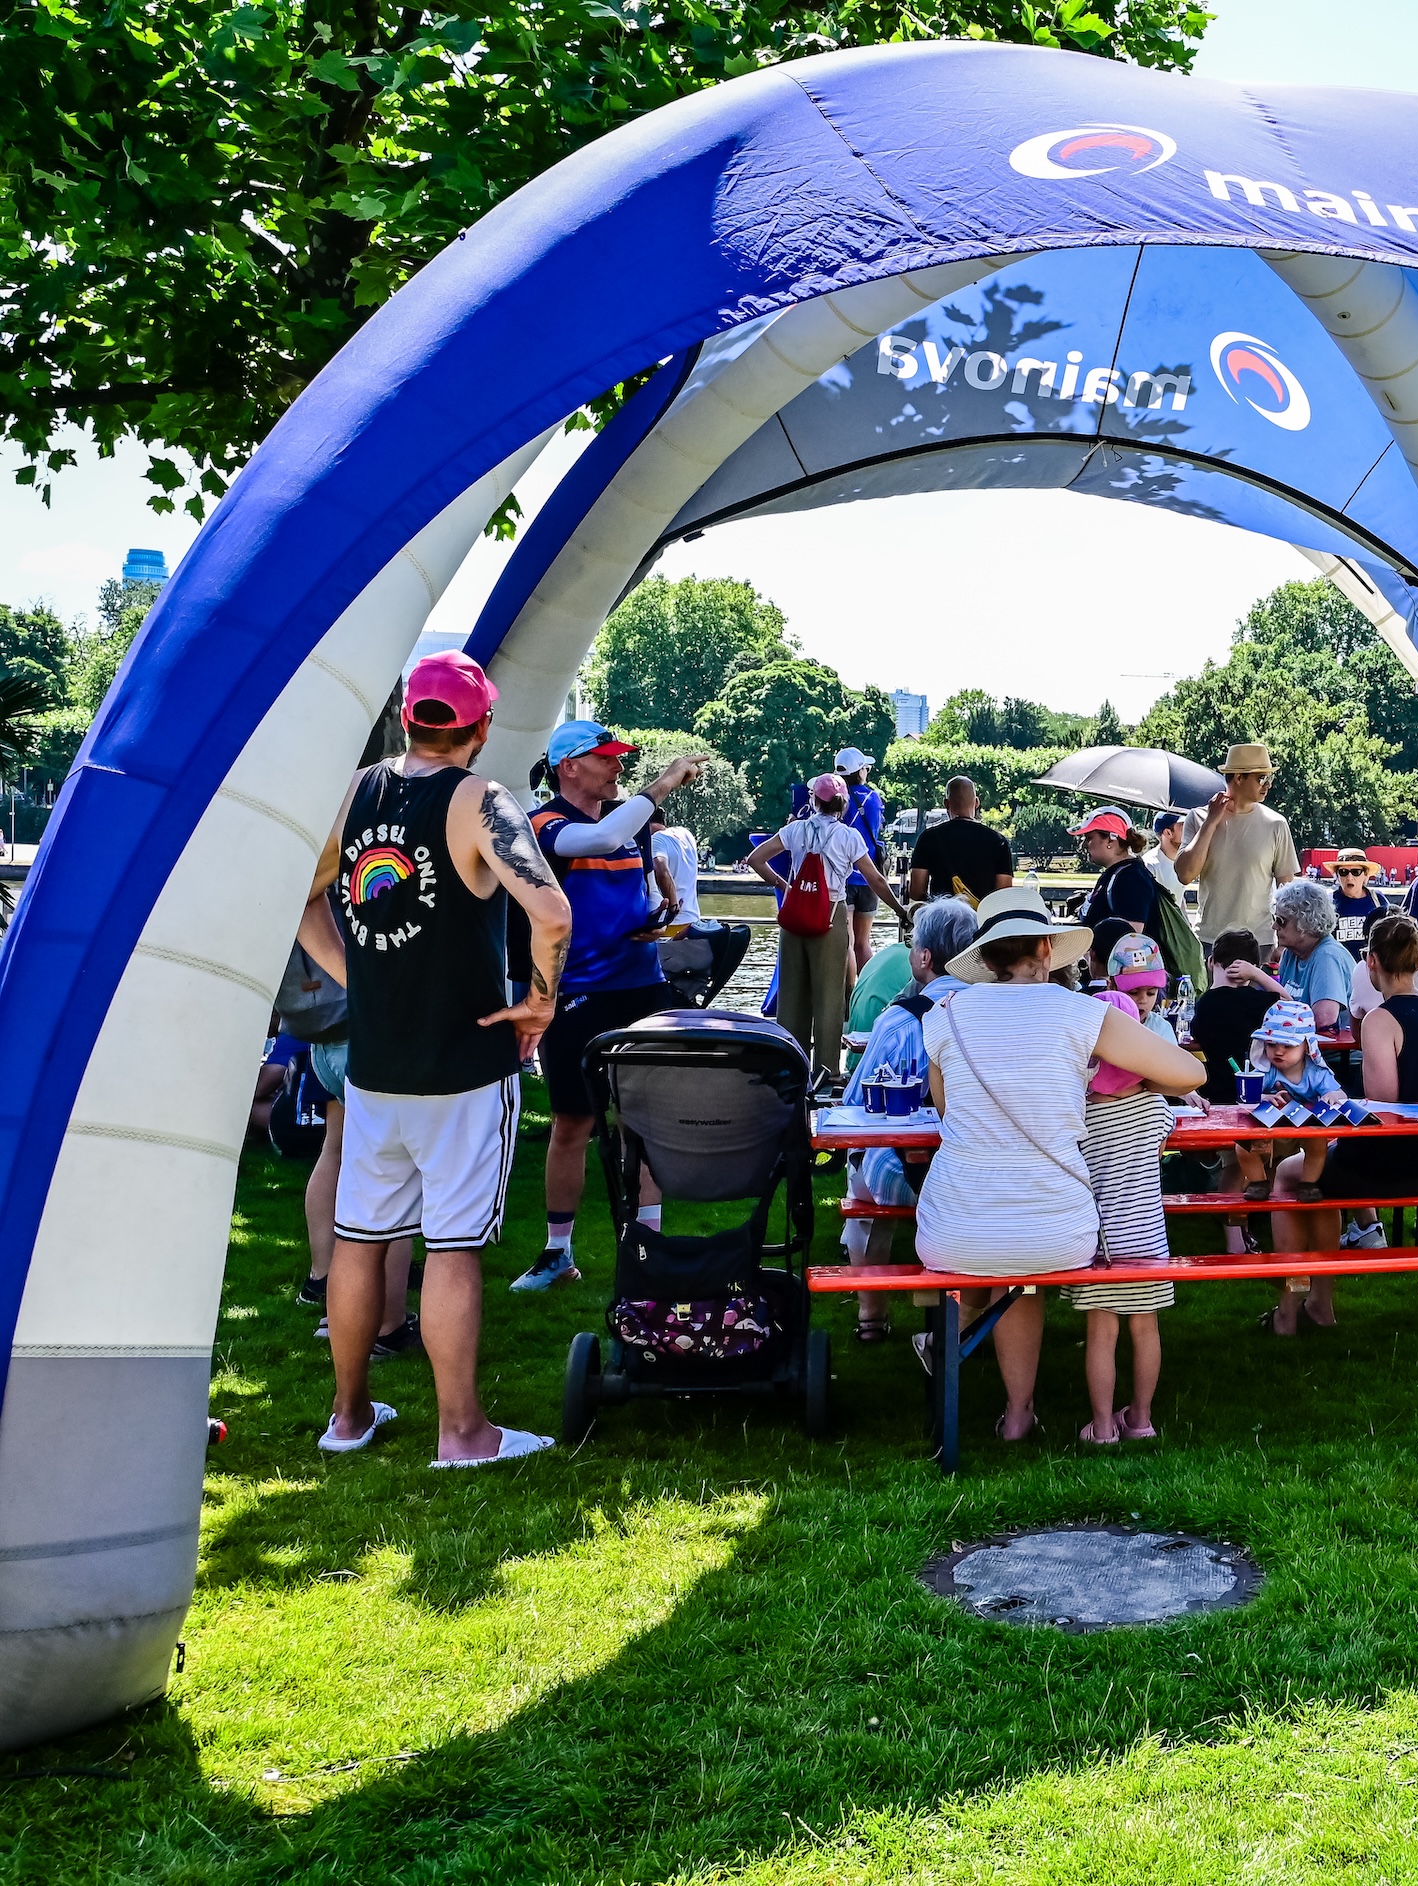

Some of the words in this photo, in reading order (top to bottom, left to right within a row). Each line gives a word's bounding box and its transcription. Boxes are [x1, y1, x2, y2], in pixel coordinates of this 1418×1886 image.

[345, 824, 405, 862] DIESEL
[414, 846, 437, 908] ONLY
[375, 921, 421, 951] THE
[1338, 930, 1365, 940] LEM
[1339, 917, 1366, 928] TEA
